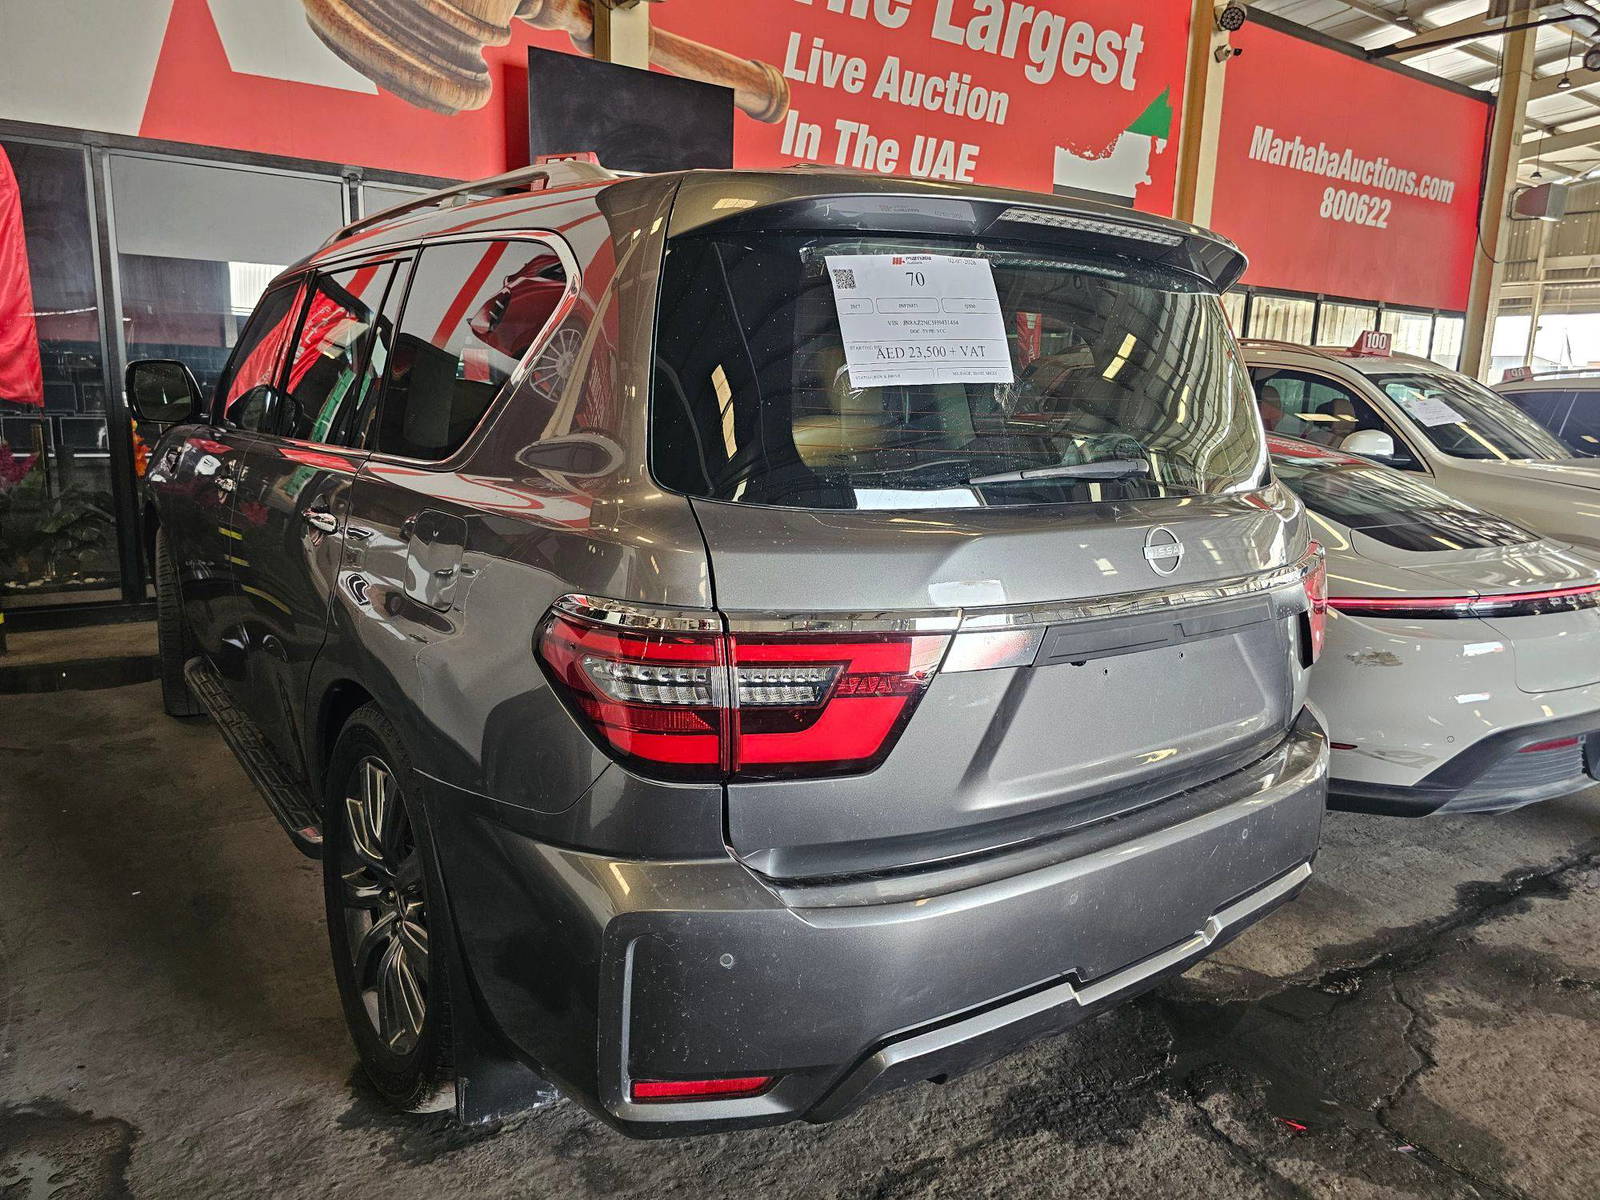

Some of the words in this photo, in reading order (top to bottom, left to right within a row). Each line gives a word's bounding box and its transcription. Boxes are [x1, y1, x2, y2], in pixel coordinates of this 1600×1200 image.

[783, 32, 866, 94] Live
[872, 56, 1010, 125] Auction
[780, 109, 822, 161] In
[834, 118, 900, 173] The
[910, 135, 980, 183] UAE
[1249, 125, 1455, 204] MarhabaAuctions.com
[1319, 187, 1392, 229] 800622
[905, 272, 925, 287] 70
[876, 347, 905, 360] AED
[908, 346, 947, 360] 23,500
[959, 346, 986, 357] VAT
[1367, 333, 1387, 350] 100
